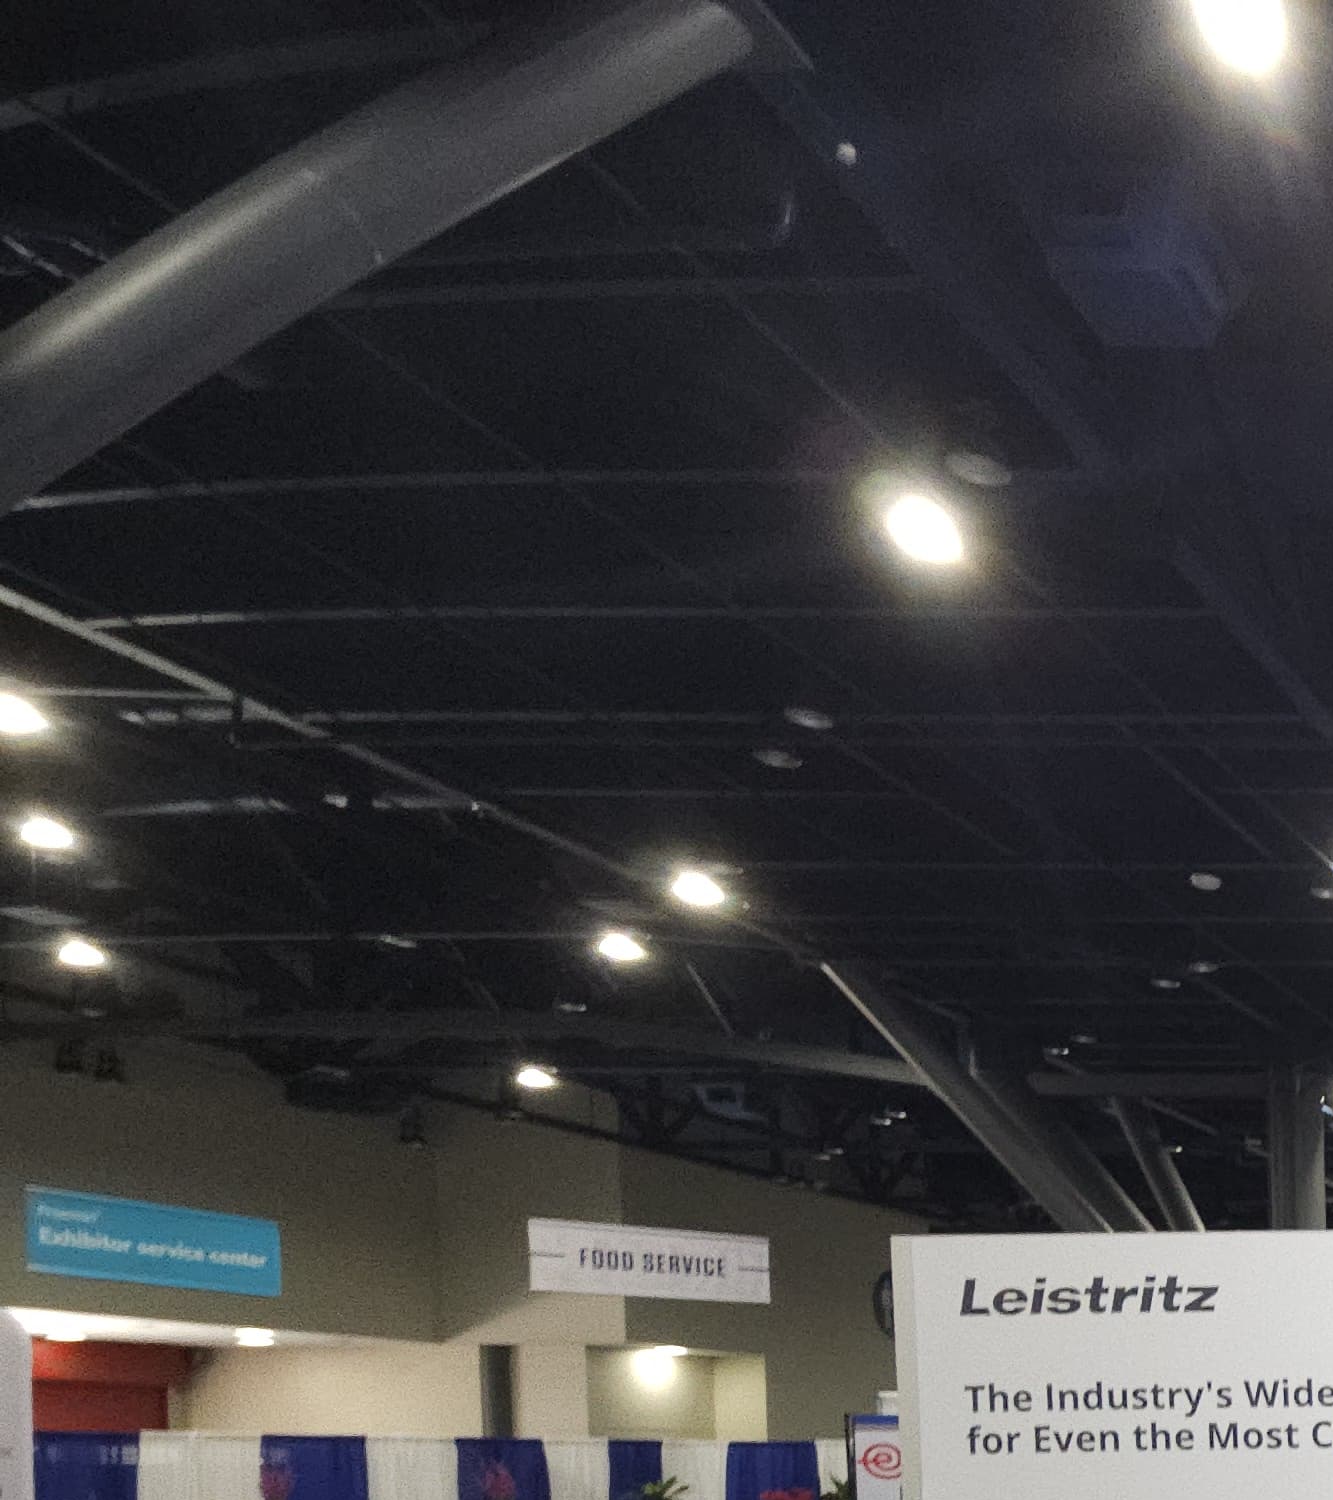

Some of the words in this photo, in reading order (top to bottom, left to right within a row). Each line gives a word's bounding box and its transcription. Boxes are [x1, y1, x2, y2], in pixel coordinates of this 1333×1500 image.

[580, 1248, 634, 1272] FOOD
[642, 1252, 725, 1278] SERVICE
[959, 1275, 1219, 1317] Leistritz
[964, 1383, 1033, 1413] The
[1045, 1380, 1234, 1418] Industry's
[967, 1425, 1021, 1456] for
[1034, 1422, 1120, 1454] Even
[1133, 1420, 1195, 1451] the
[1208, 1420, 1300, 1450] Most
